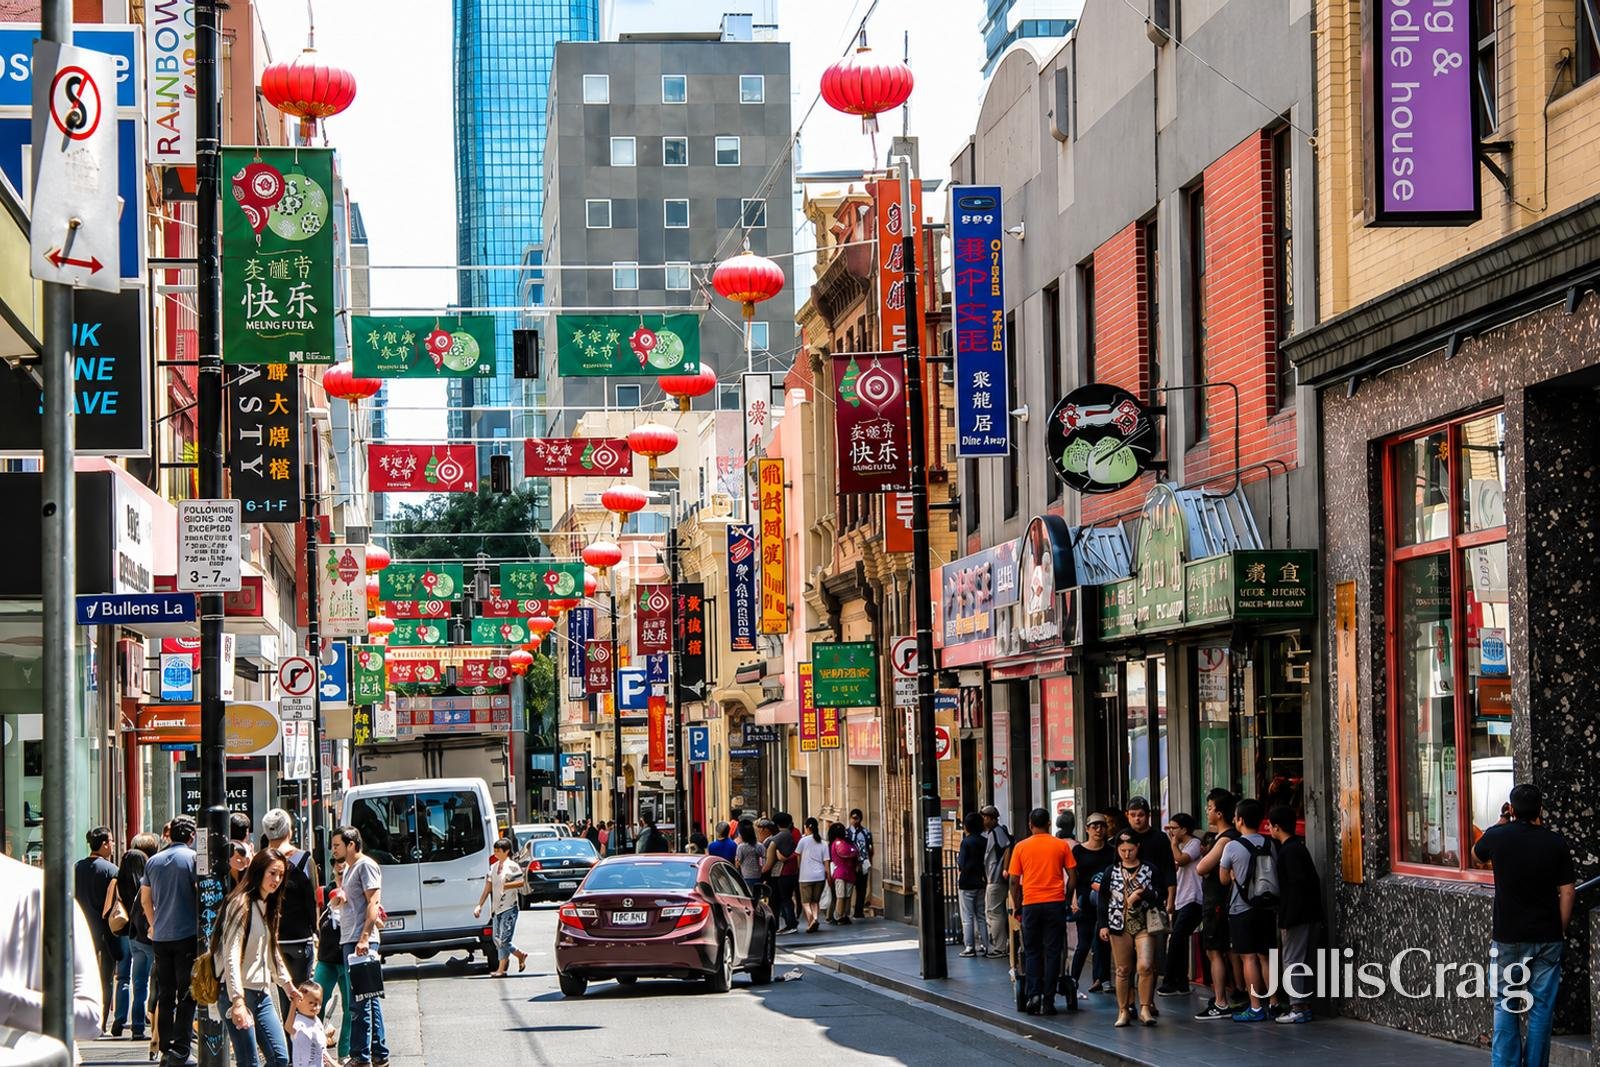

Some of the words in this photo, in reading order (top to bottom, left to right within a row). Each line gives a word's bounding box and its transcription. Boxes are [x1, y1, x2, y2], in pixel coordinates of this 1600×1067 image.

[1390, 0, 1420, 68] dle
[155, 0, 181, 155] RAINBOW
[1432, 48, 1463, 77] &
[1391, 82, 1420, 202] house
[241, 282, 318, 319] 快乐
[849, 440, 899, 464] 快乐
[102, 601, 159, 616] Bullens
[164, 600, 184, 615] La
[621, 673, 646, 706] P
[693, 731, 704, 745] P
